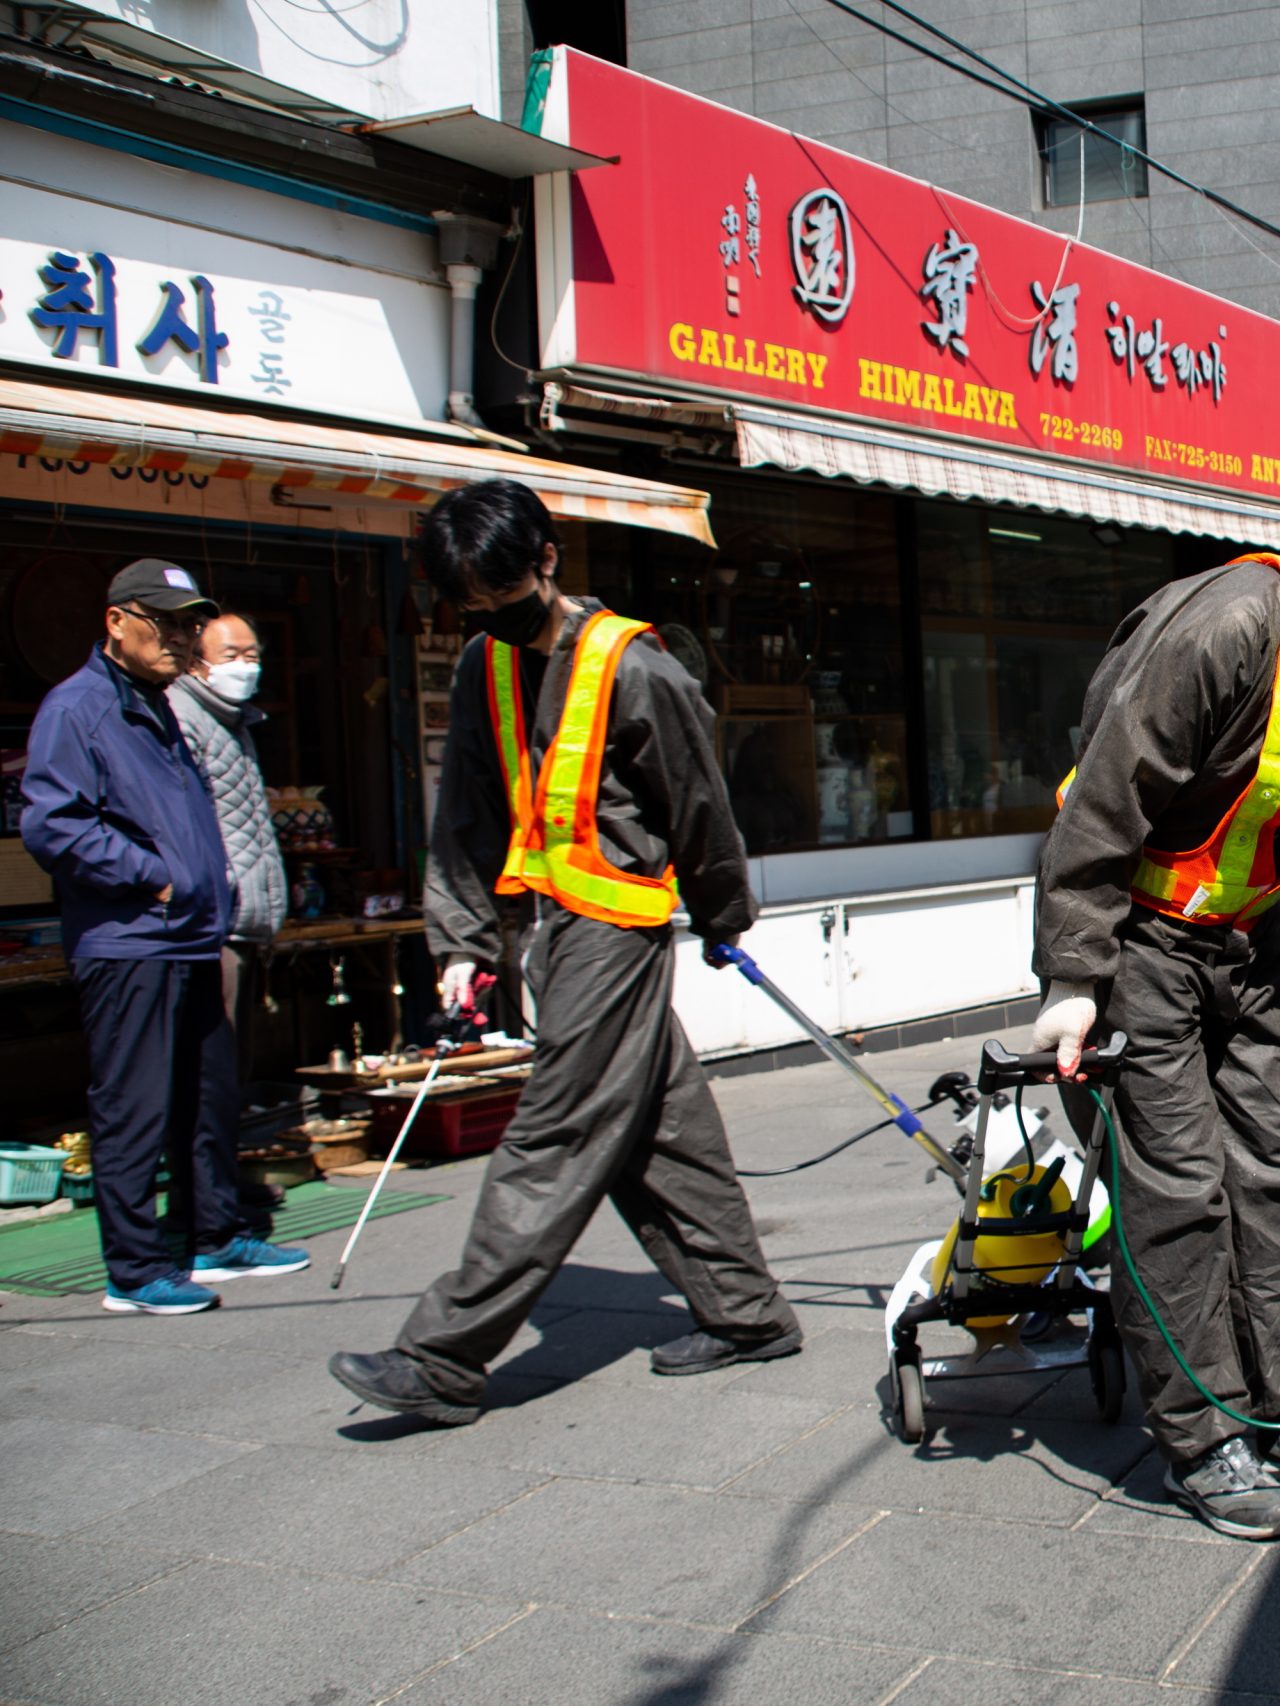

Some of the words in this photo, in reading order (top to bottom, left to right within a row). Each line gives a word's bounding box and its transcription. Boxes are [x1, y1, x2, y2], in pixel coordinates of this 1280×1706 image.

[669, 322, 828, 388] GALLERY
[858, 358, 1018, 429] HIMALAYA
[1039, 413, 1123, 450] 722-2269
